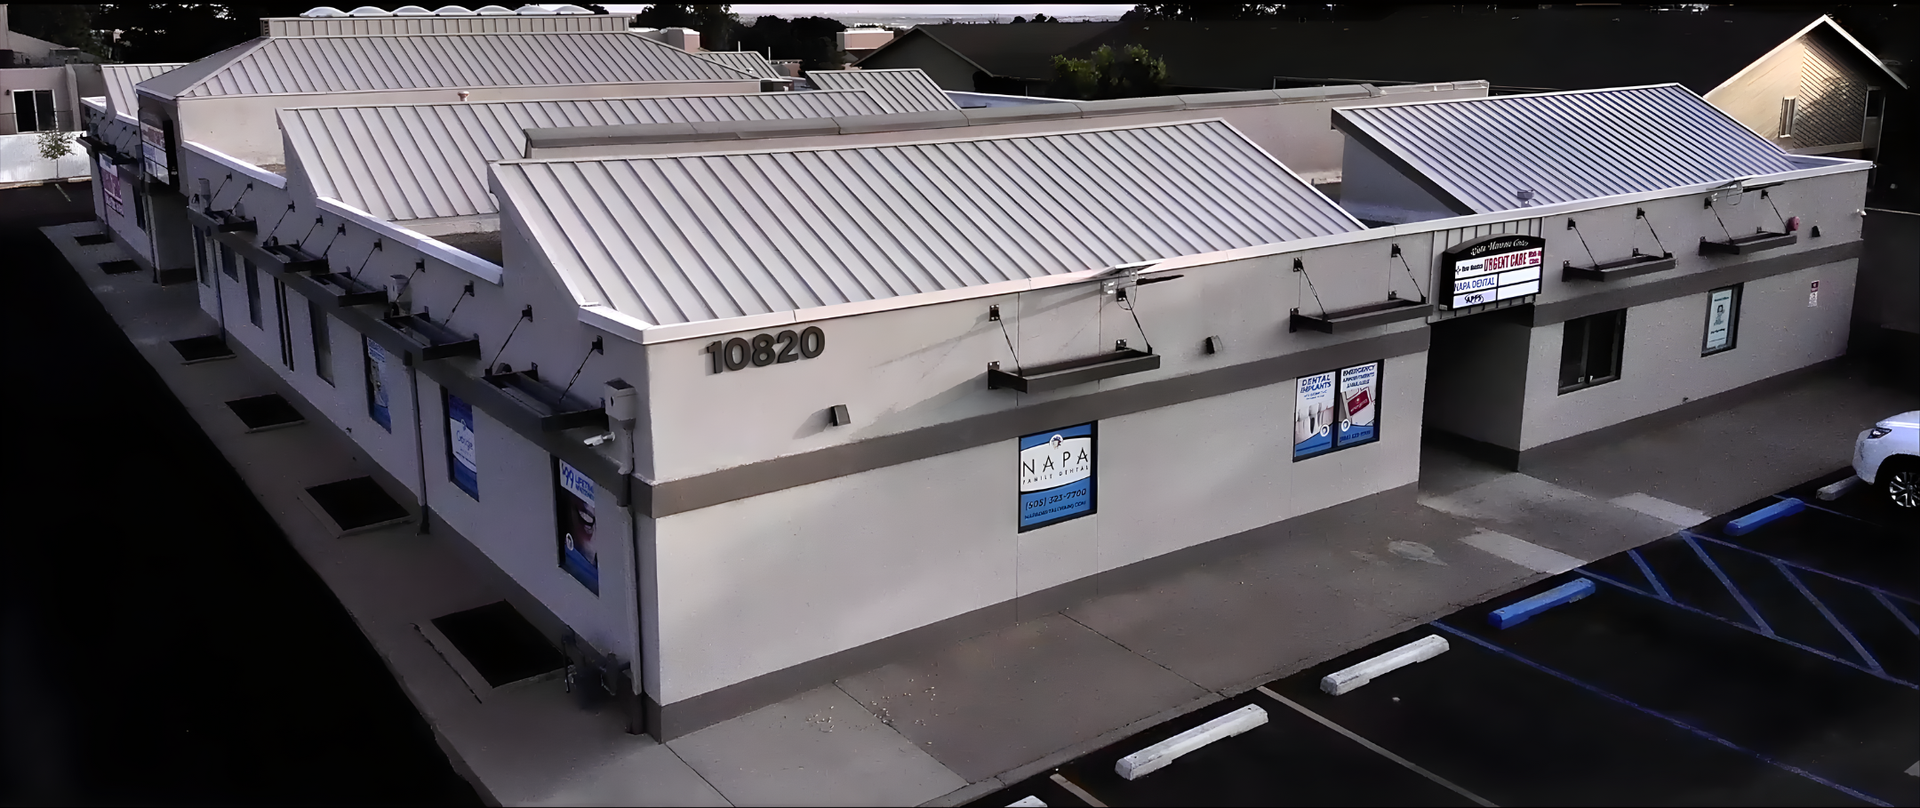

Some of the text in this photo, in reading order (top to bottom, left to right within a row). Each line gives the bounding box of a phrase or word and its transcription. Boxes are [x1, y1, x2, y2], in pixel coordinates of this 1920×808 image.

[1483, 254, 1510, 272] URGENT
[1510, 252, 1528, 267] CARE
[1454, 277, 1495, 292] NAPA DENTAL
[705, 325, 826, 374] 10820
[1300, 381, 1332, 394] IMPLANTS
[1302, 374, 1331, 387] DENTAL
[1022, 446, 1089, 478] NAPA
[1058, 465, 1089, 477] DENTAL
[1025, 497, 1047, 511] (505)
